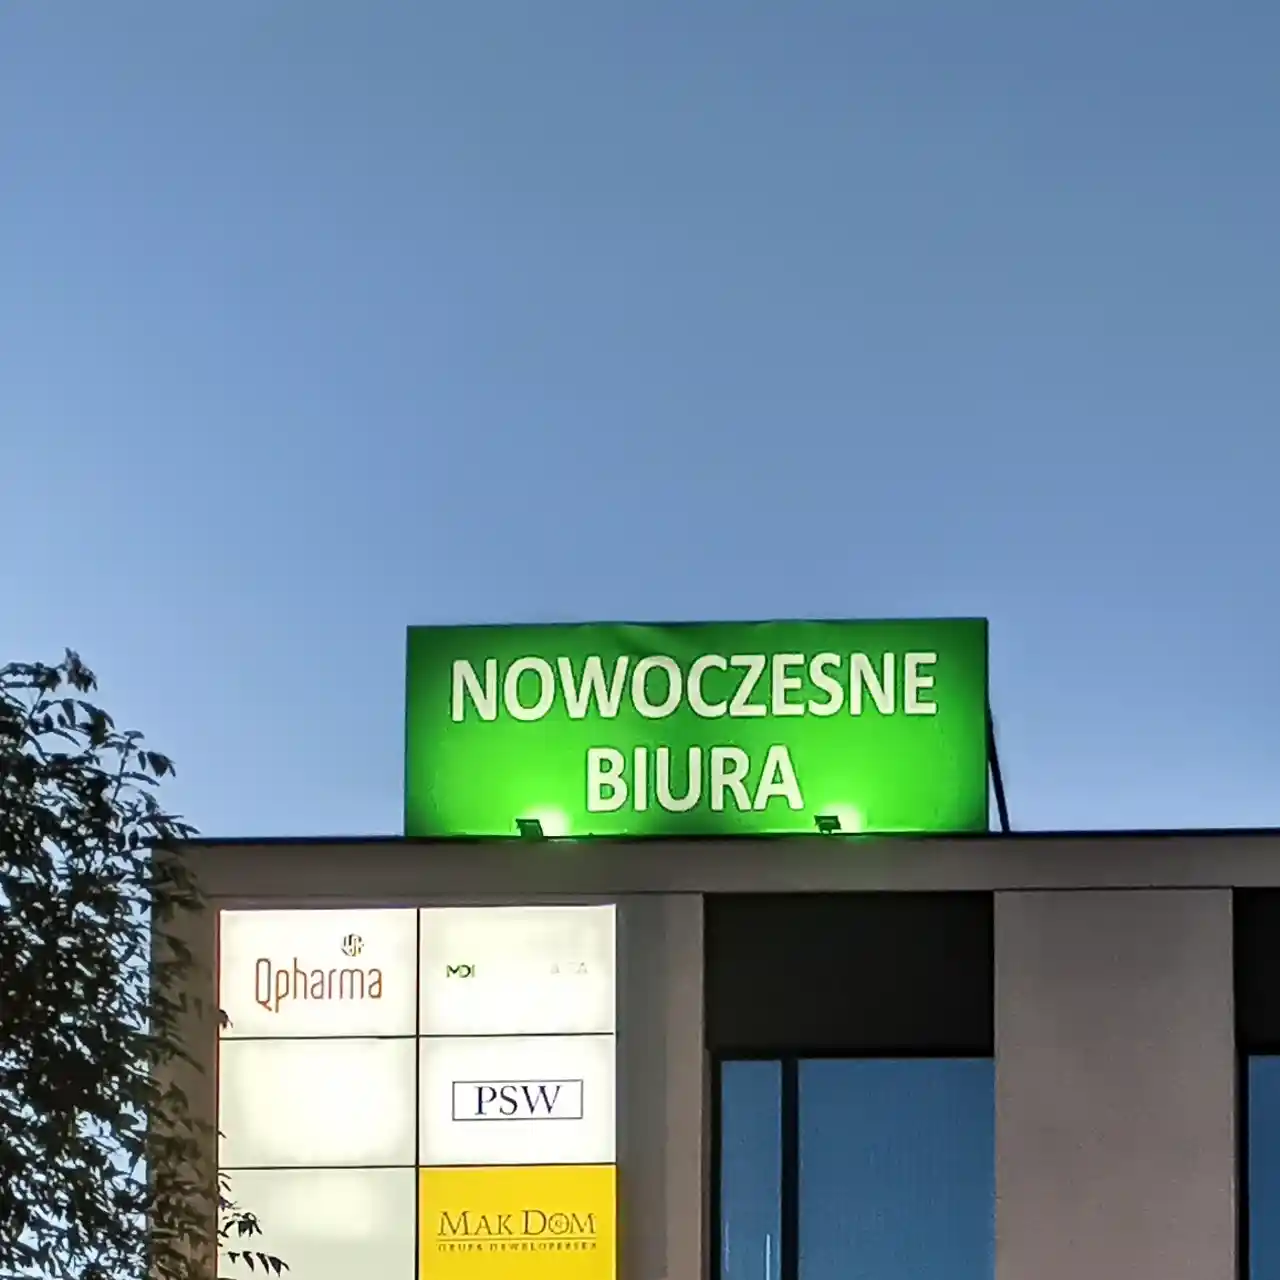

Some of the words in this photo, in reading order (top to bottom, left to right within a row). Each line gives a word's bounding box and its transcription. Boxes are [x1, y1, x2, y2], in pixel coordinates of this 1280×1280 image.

[450, 652, 938, 722] NOWOCZESNE
[586, 745, 804, 813] BIURA
[255, 957, 383, 1013] Qpharma
[474, 1084, 563, 1117] PSW
